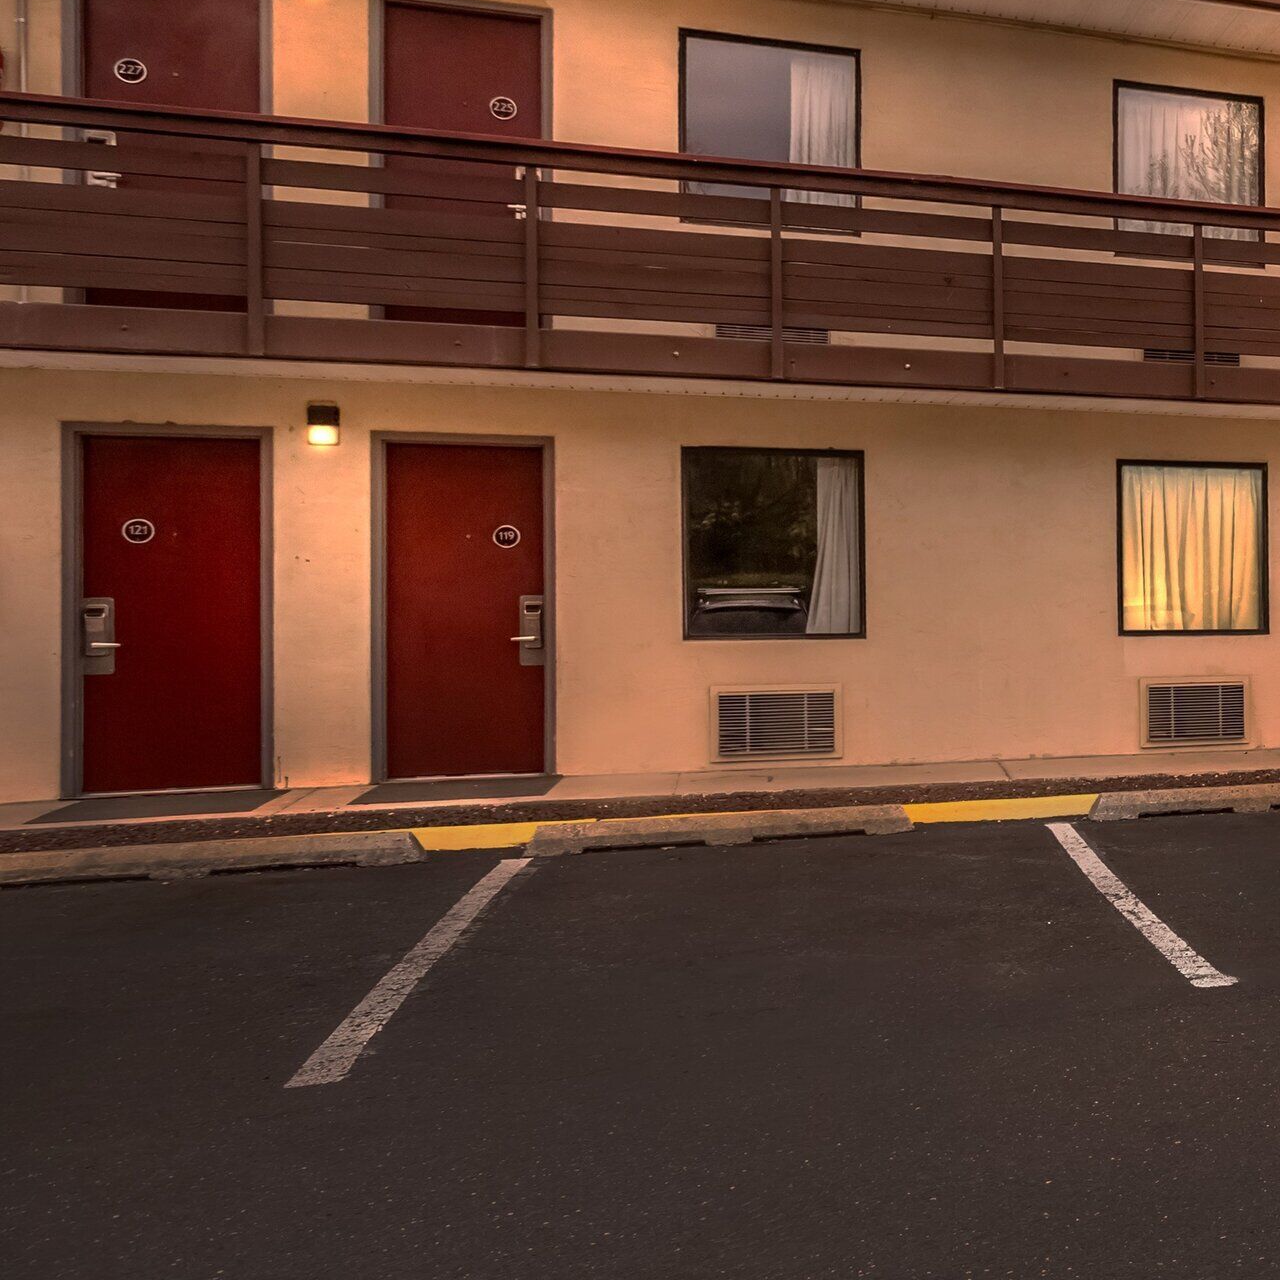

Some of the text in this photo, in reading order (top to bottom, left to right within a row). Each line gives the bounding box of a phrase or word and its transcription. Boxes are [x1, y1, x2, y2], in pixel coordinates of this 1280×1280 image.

[118, 63, 143, 75] 227
[493, 101, 514, 113] 225
[128, 524, 148, 535] 121
[498, 530, 515, 541] 119
